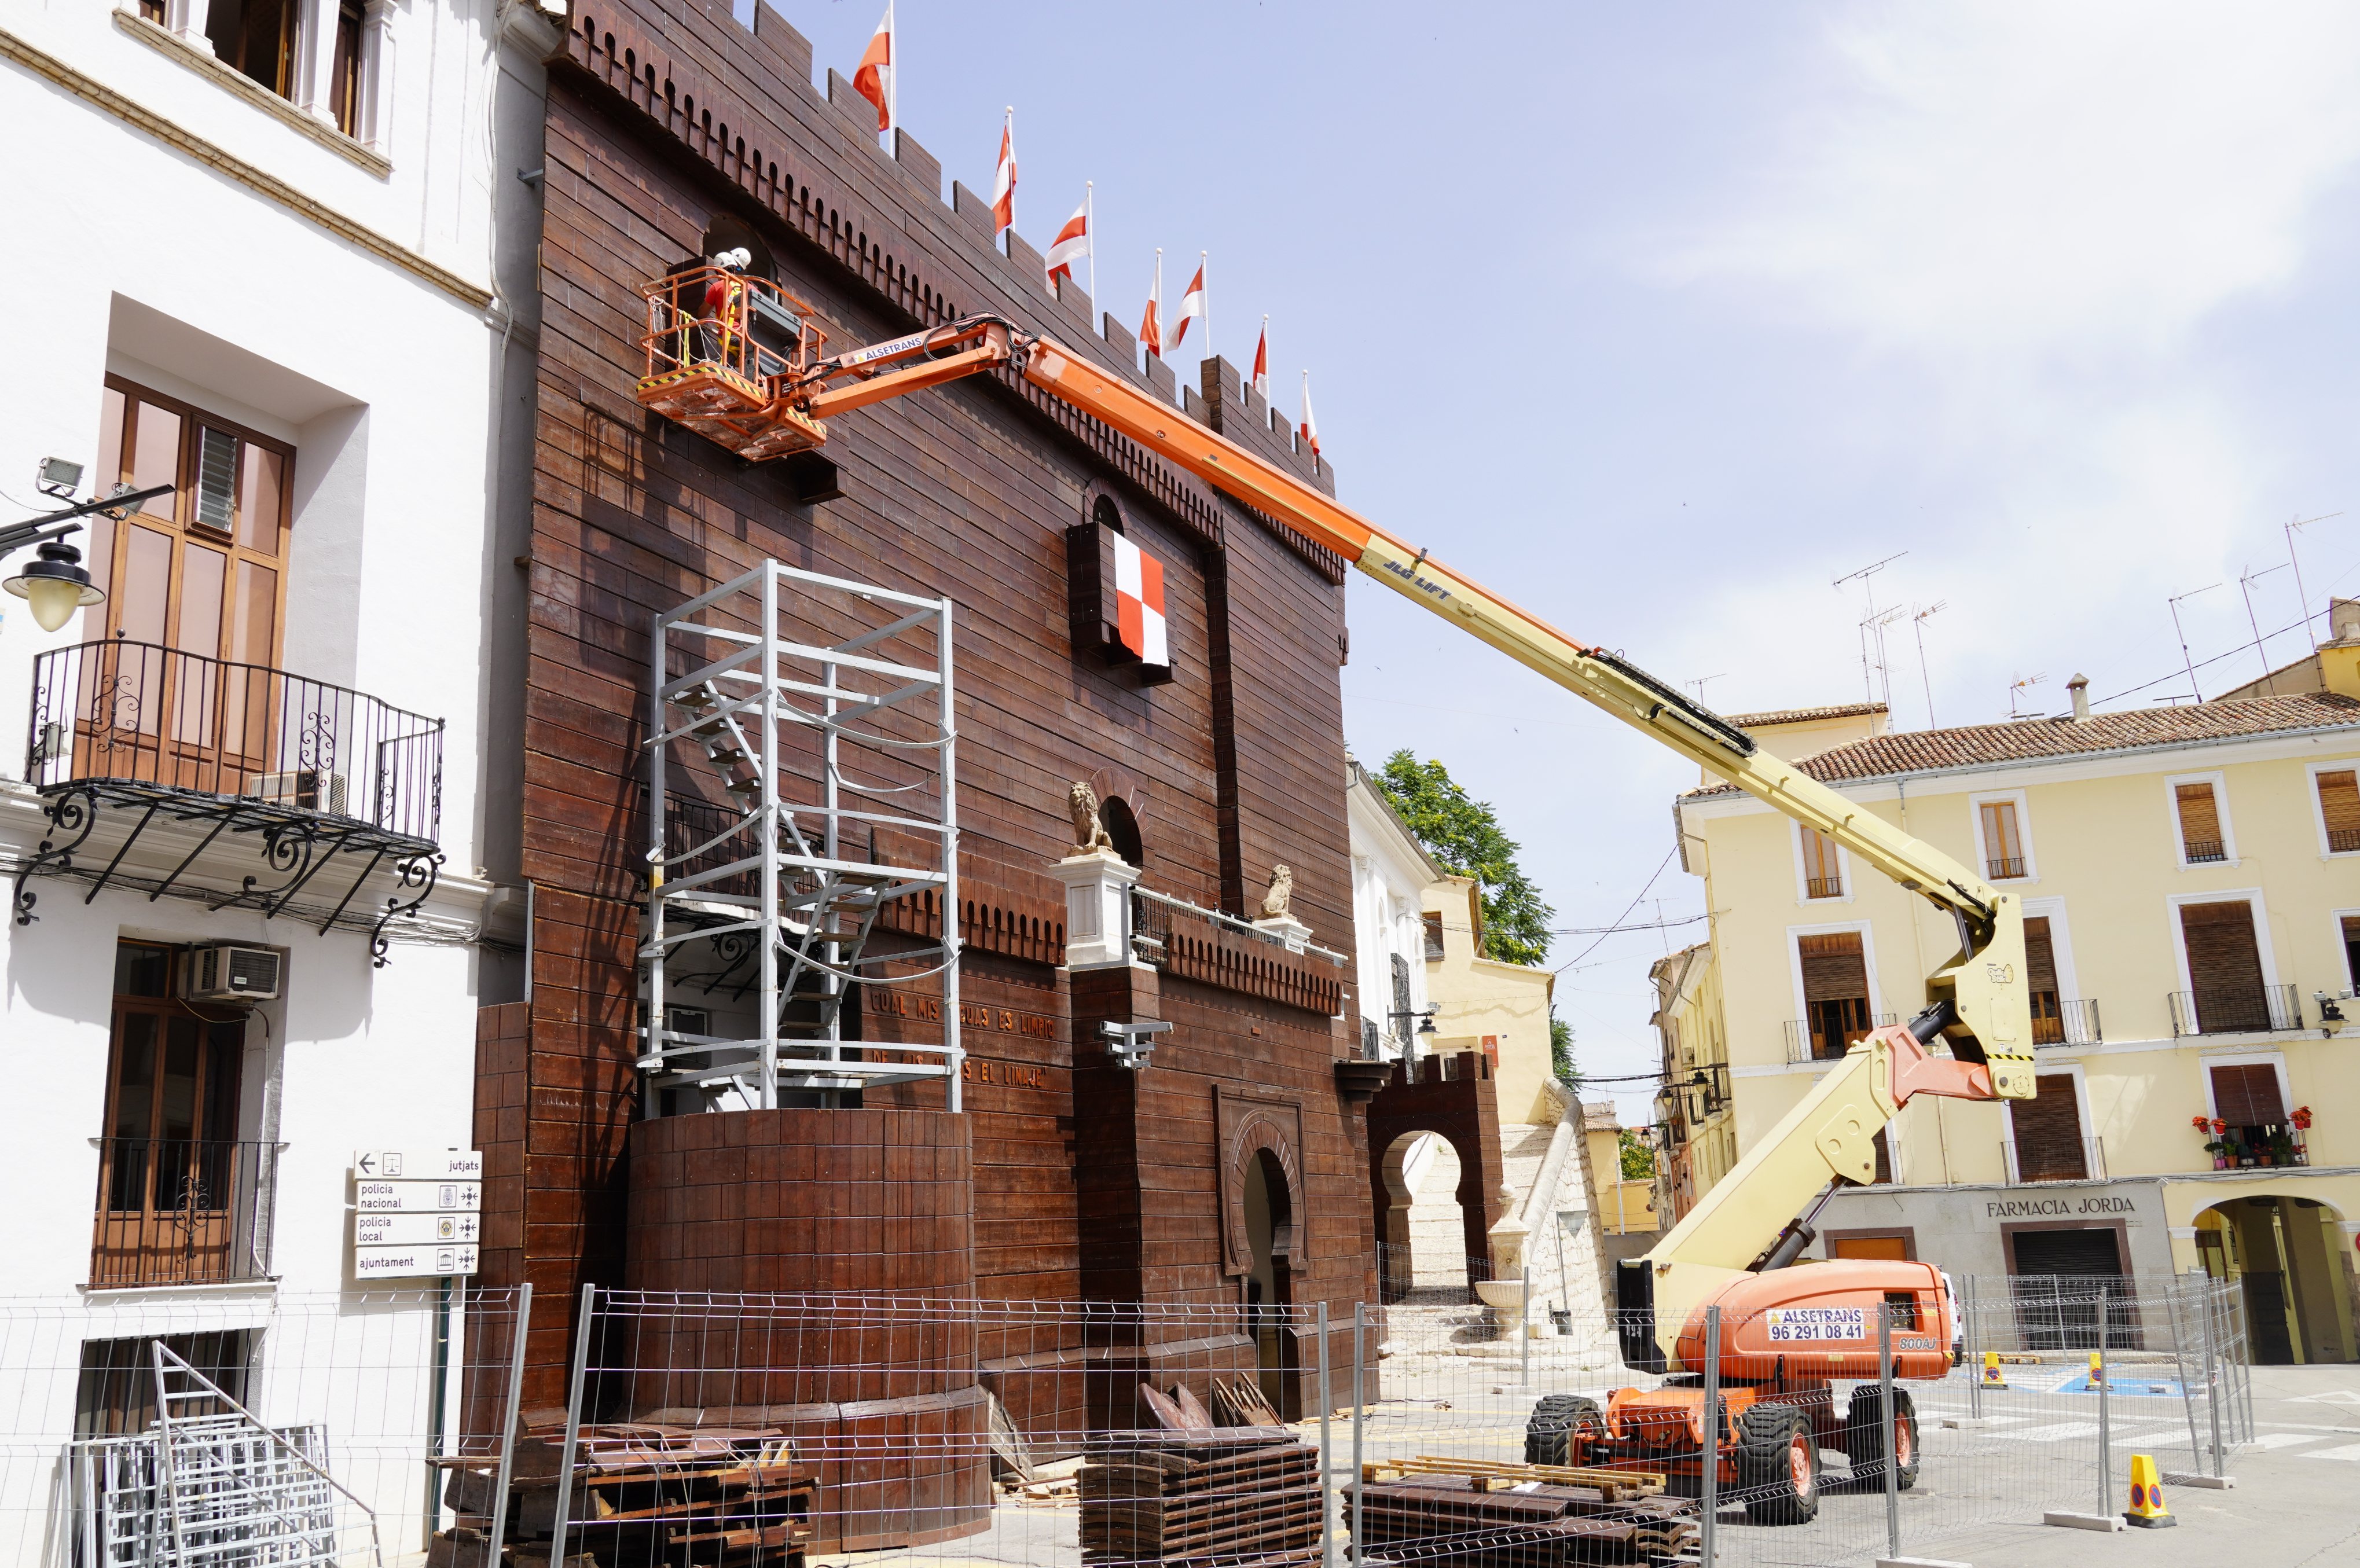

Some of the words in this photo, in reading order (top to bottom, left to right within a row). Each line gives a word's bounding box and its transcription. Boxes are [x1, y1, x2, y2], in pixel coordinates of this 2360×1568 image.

[866, 337, 922, 360] ALSETRANS
[1382, 560, 1416, 580] JLG
[1414, 576, 1452, 601] LIFT
[871, 992, 908, 1015] CUAL
[917, 998, 939, 1020] MIS
[959, 1004, 989, 1027] GUAS
[998, 1010, 1012, 1030] ES
[981, 1062, 994, 1083] EL
[449, 1160, 479, 1172] jutjats
[361, 1184, 393, 1196] policia
[361, 1198, 402, 1208] nacional
[1987, 1199, 2071, 1217] FARMACIA
[2079, 1197, 2135, 1213] JORDA
[359, 1216, 391, 1229] policia
[359, 1231, 383, 1242] local
[359, 1256, 414, 1270] ajuntament
[1783, 1309, 1862, 1323] ALSETRANS
[1771, 1325, 1790, 1340] 96
[1794, 1325, 1819, 1340] 291
[1825, 1324, 1842, 1339] 08
[1847, 1324, 1862, 1338] 41
[1899, 1337, 1937, 1350] 800AJ
